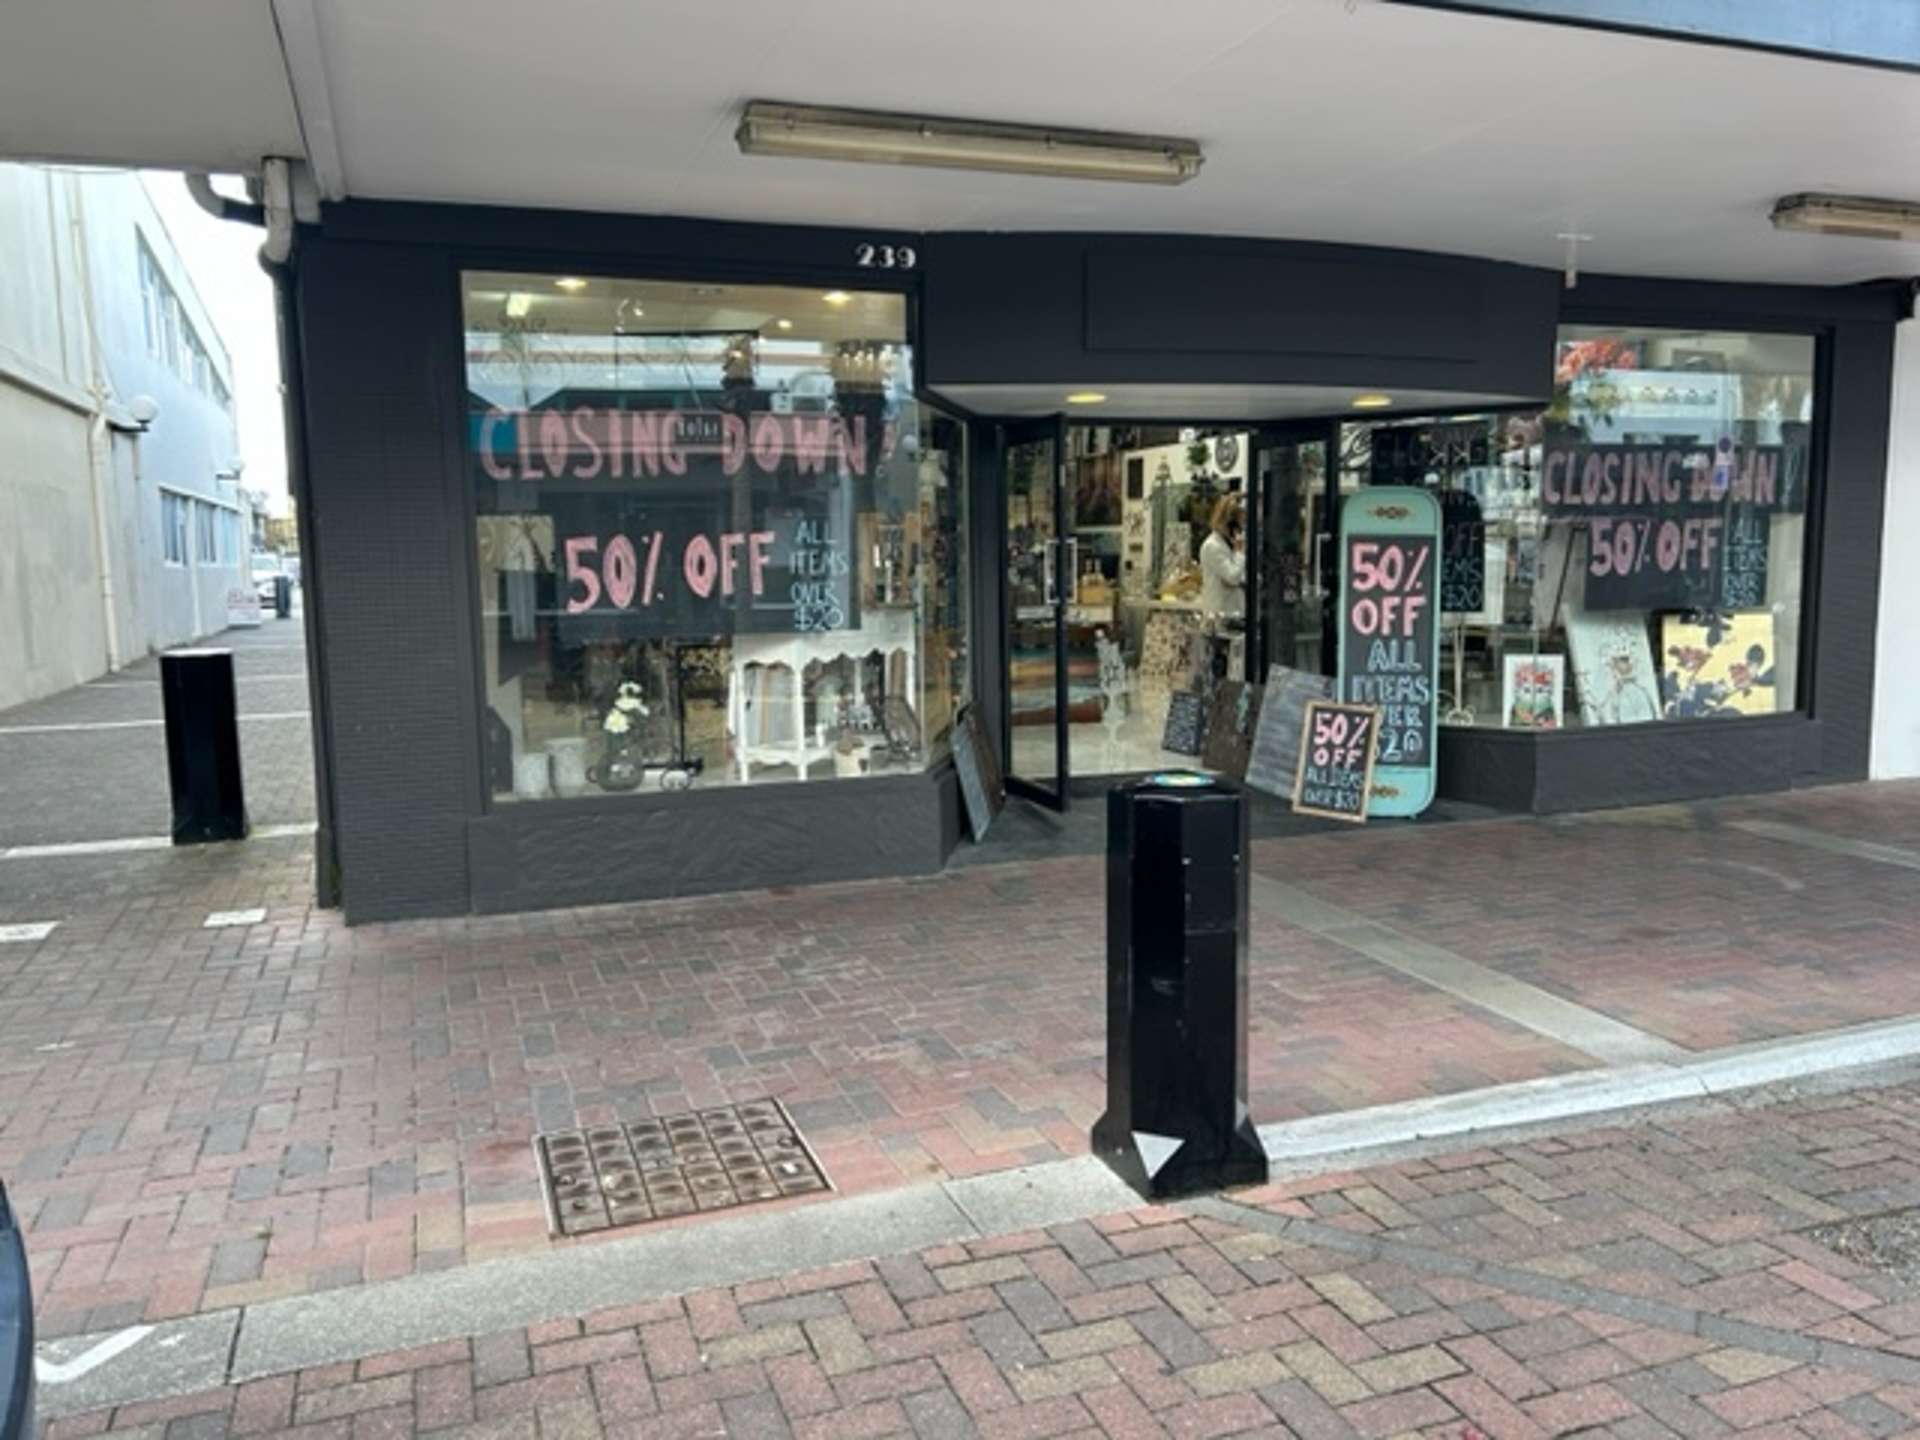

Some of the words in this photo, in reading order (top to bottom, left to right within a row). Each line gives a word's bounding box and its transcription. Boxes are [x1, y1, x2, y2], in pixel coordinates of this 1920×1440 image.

[856, 243, 916, 269] 239
[480, 407, 687, 480] CLOSING
[1543, 450, 1682, 505] CLOSING
[796, 520, 838, 544] ALL
[1731, 516, 1763, 543] ALL
[789, 549, 849, 577] ITEMS
[1589, 517, 1650, 577] 50%
[1656, 518, 1724, 572] OFF
[565, 531, 664, 613] 50%
[684, 531, 776, 598] OFF
[1352, 542, 1429, 592] 50%
[1352, 596, 1426, 636] OFF
[1368, 638, 1422, 672] ALL
[1351, 673, 1429, 705] ITEMS
[1313, 712, 1369, 748] 50%
[1374, 728, 1424, 762] 20
[1313, 747, 1362, 768] OFF
